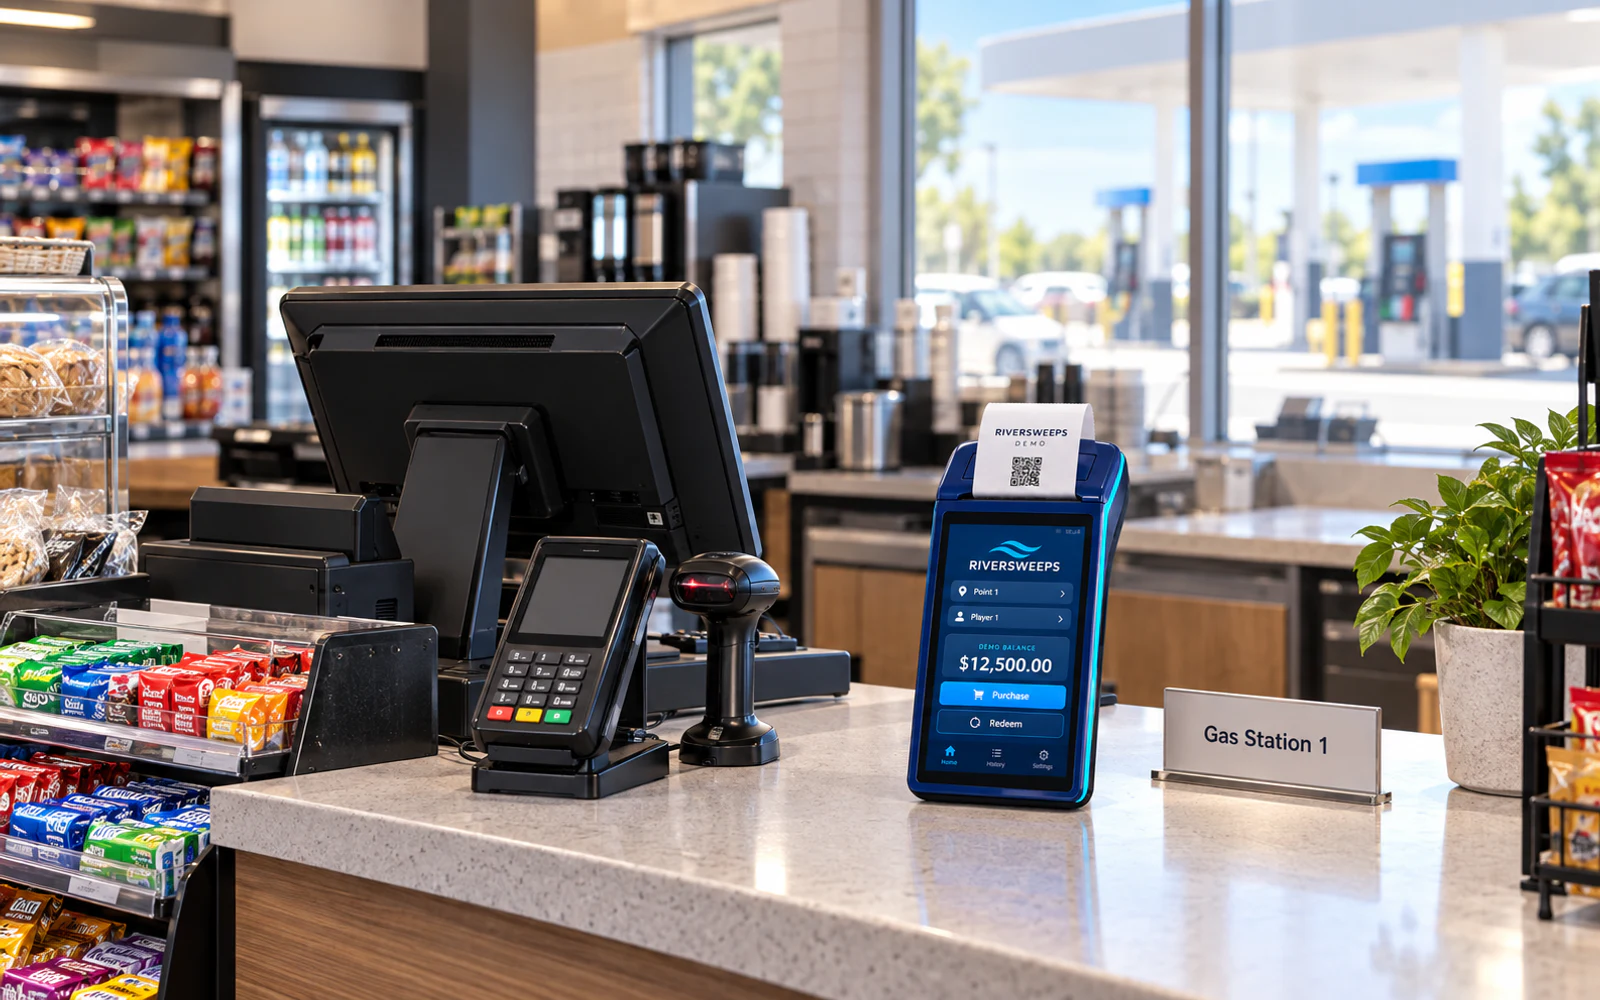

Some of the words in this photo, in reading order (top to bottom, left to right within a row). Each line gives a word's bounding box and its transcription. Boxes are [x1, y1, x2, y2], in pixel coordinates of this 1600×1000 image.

[994, 428, 1068, 437] RIVERSWEEPS
[969, 560, 1060, 572] RIVERSWEEPS
[973, 587, 993, 596] Point
[970, 613, 993, 622] Player
[978, 643, 1000, 651] DEMO
[1002, 644, 1036, 652] BALANCE
[959, 655, 1053, 674] $12,500.00
[992, 690, 1030, 701] Purchase
[989, 719, 1023, 728] Redeem
[1204, 725, 1238, 745] Gas
[1244, 729, 1312, 753] Station
[1318, 736, 1328, 755] 1
[986, 761, 1005, 769] History
[1032, 763, 1053, 771] Settings
